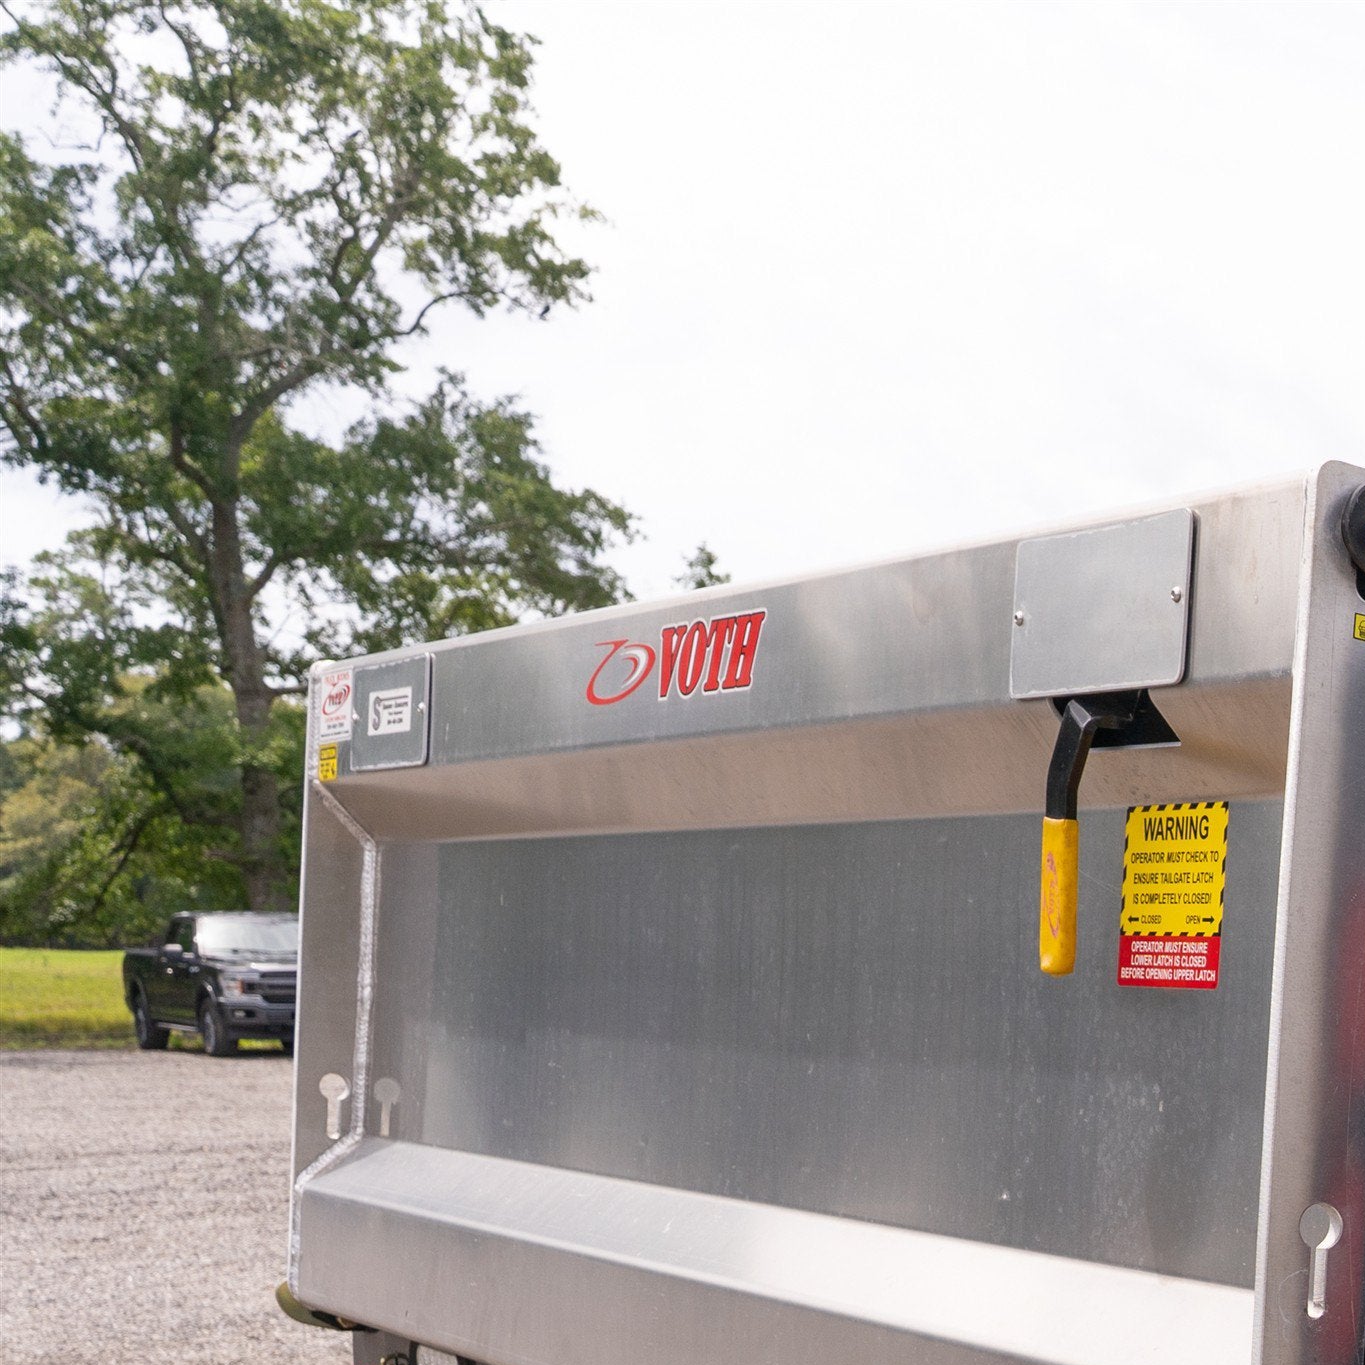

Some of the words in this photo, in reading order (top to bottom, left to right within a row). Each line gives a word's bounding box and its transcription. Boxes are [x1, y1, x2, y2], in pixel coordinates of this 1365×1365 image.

[659, 609, 767, 699] VOTH
[1143, 815, 1209, 842] WARNING
[1131, 852, 1166, 864] OPERATOR
[1167, 852, 1185, 863] MUST
[1185, 851, 1209, 863] CHECK
[1210, 850, 1220, 863] TO
[1133, 873, 1159, 885] ENSURE
[1160, 872, 1191, 884] TAILGATE
[1192, 872, 1214, 884] LATCH
[1133, 893, 1139, 905] IS
[1140, 893, 1181, 905] COMPLETELY
[1182, 892, 1212, 905] CLOSED!
[1140, 915, 1162, 925] CLOSED
[1185, 915, 1201, 925] OPEN
[1131, 941, 1164, 953] OPERATOR
[1164, 941, 1182, 954] MUST
[1182, 941, 1209, 954] ENSURE
[1130, 954, 1153, 966] LOWER
[1153, 955, 1174, 967] LATCH
[1173, 955, 1181, 967] IS
[1180, 956, 1208, 968] CLOSED
[1120, 967, 1146, 980] BEFORE
[1145, 968, 1174, 981] OPENING
[1173, 969, 1195, 982] UPPER
[1195, 970, 1217, 983] LATCH
